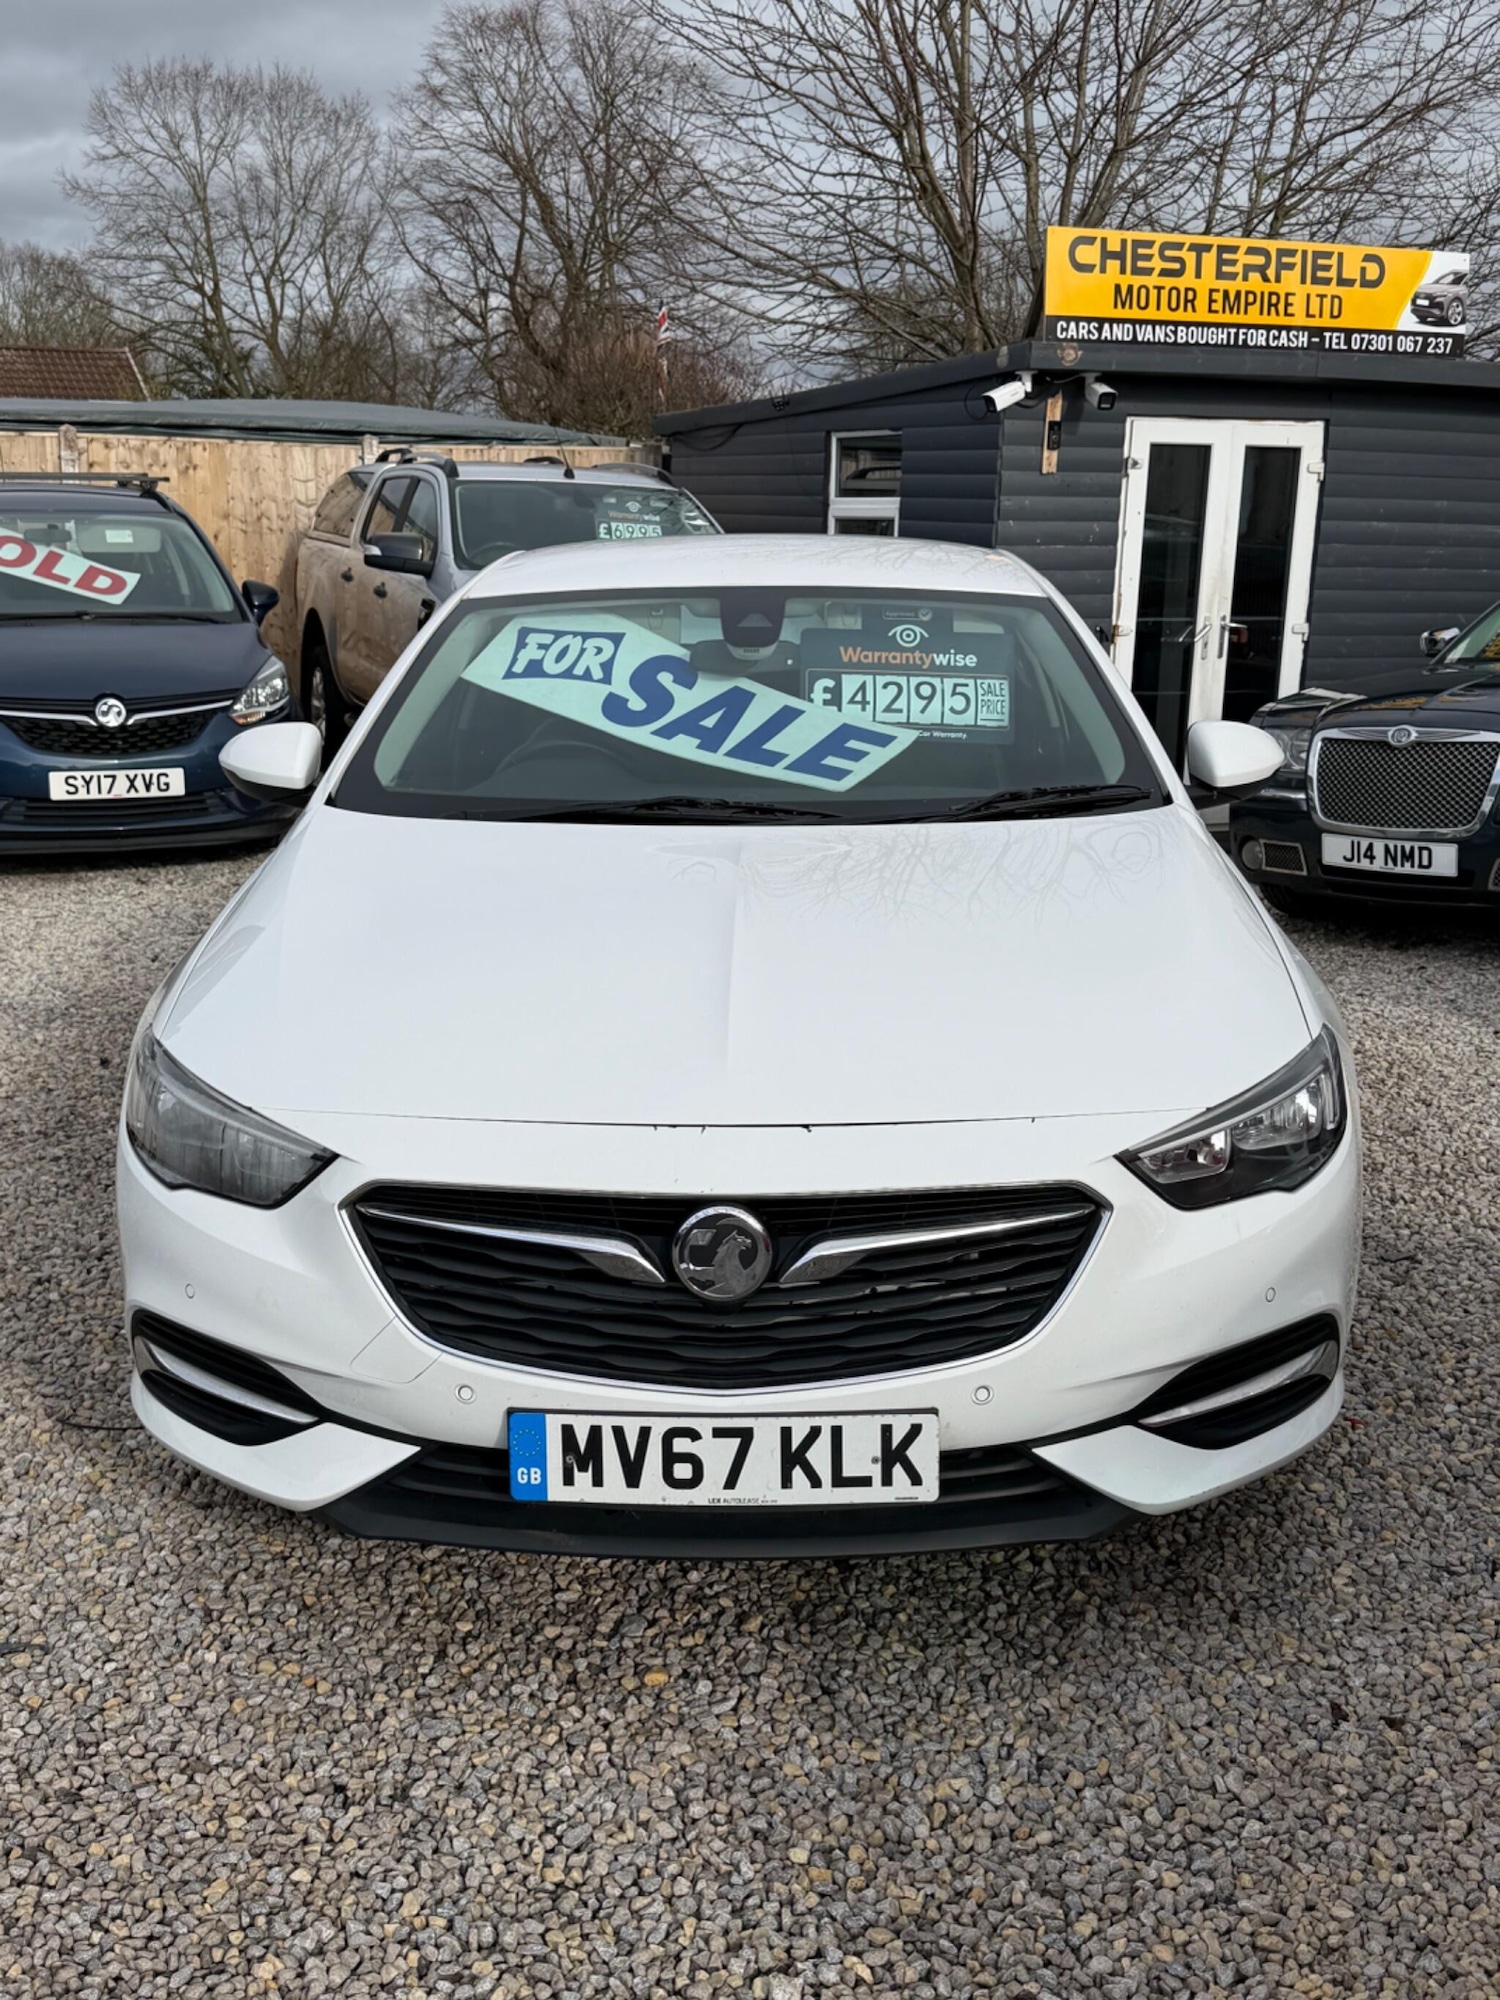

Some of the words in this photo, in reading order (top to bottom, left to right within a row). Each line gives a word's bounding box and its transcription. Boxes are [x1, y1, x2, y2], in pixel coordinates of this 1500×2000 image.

[1068, 235, 1386, 289] CHESTERFIELD
[1113, 283, 1197, 313] MOTOR
[1207, 288, 1295, 317] EMPIRE
[1305, 293, 1343, 319] LTD
[1057, 321, 1099, 340] CARS
[1101, 323, 1133, 341] AND
[1135, 324, 1175, 343] VANS
[1177, 326, 1238, 346] BOUGHT
[1239, 328, 1267, 347] FOR
[1269, 329, 1308, 348] CASH
[1323, 332, 1348, 350] TEL
[1351, 333, 1393, 351] 07301
[1397, 335, 1423, 353] 067
[1427, 336, 1453, 354] 237
[839, 646, 978, 669] Warrantywise
[979, 681, 1006, 697] SALE
[511, 632, 621, 682] FOR
[601, 653, 899, 782] SALE
[979, 698, 1006, 715] PRICE
[64, 774, 118, 796] SY17
[125, 773, 171, 793] XVG
[1343, 840, 1376, 865] J14
[1384, 843, 1432, 870] NMD
[561, 1423, 754, 1490] MV67
[780, 1423, 923, 1489] KLK
[517, 1467, 542, 1485] GB
